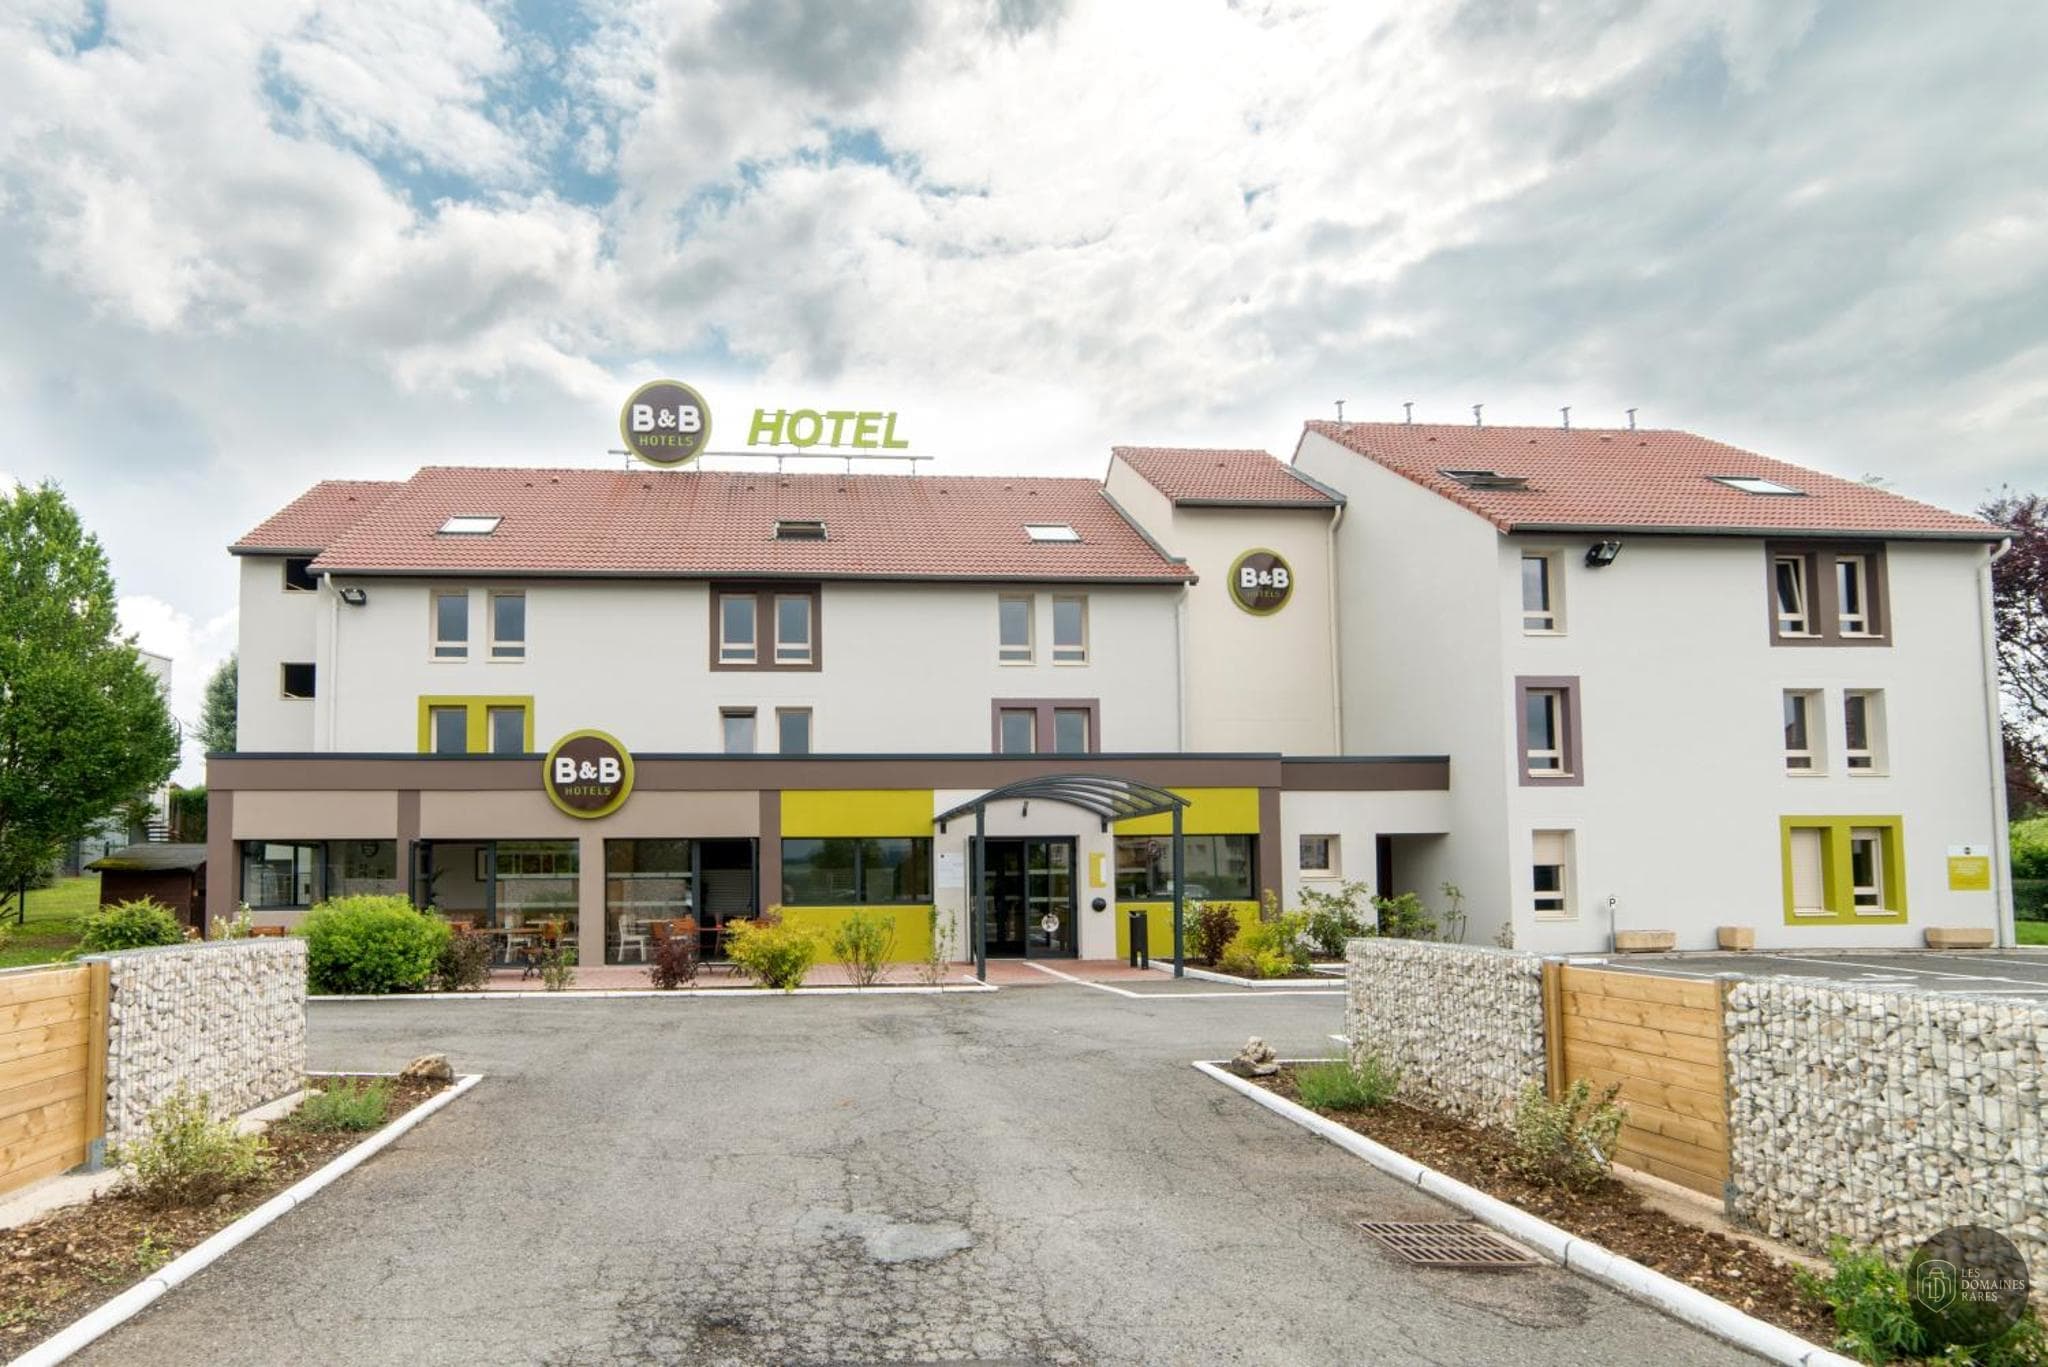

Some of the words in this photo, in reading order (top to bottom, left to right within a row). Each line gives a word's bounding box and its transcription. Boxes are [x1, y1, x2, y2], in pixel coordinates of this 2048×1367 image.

[633, 404, 701, 433] B&B
[747, 409, 909, 449] HOTEL
[639, 435, 694, 447] HOTELS
[1240, 567, 1290, 588] B&B
[555, 757, 621, 783] B&B
[564, 786, 611, 796] HOTELS
[1609, 898, 1616, 908] P
